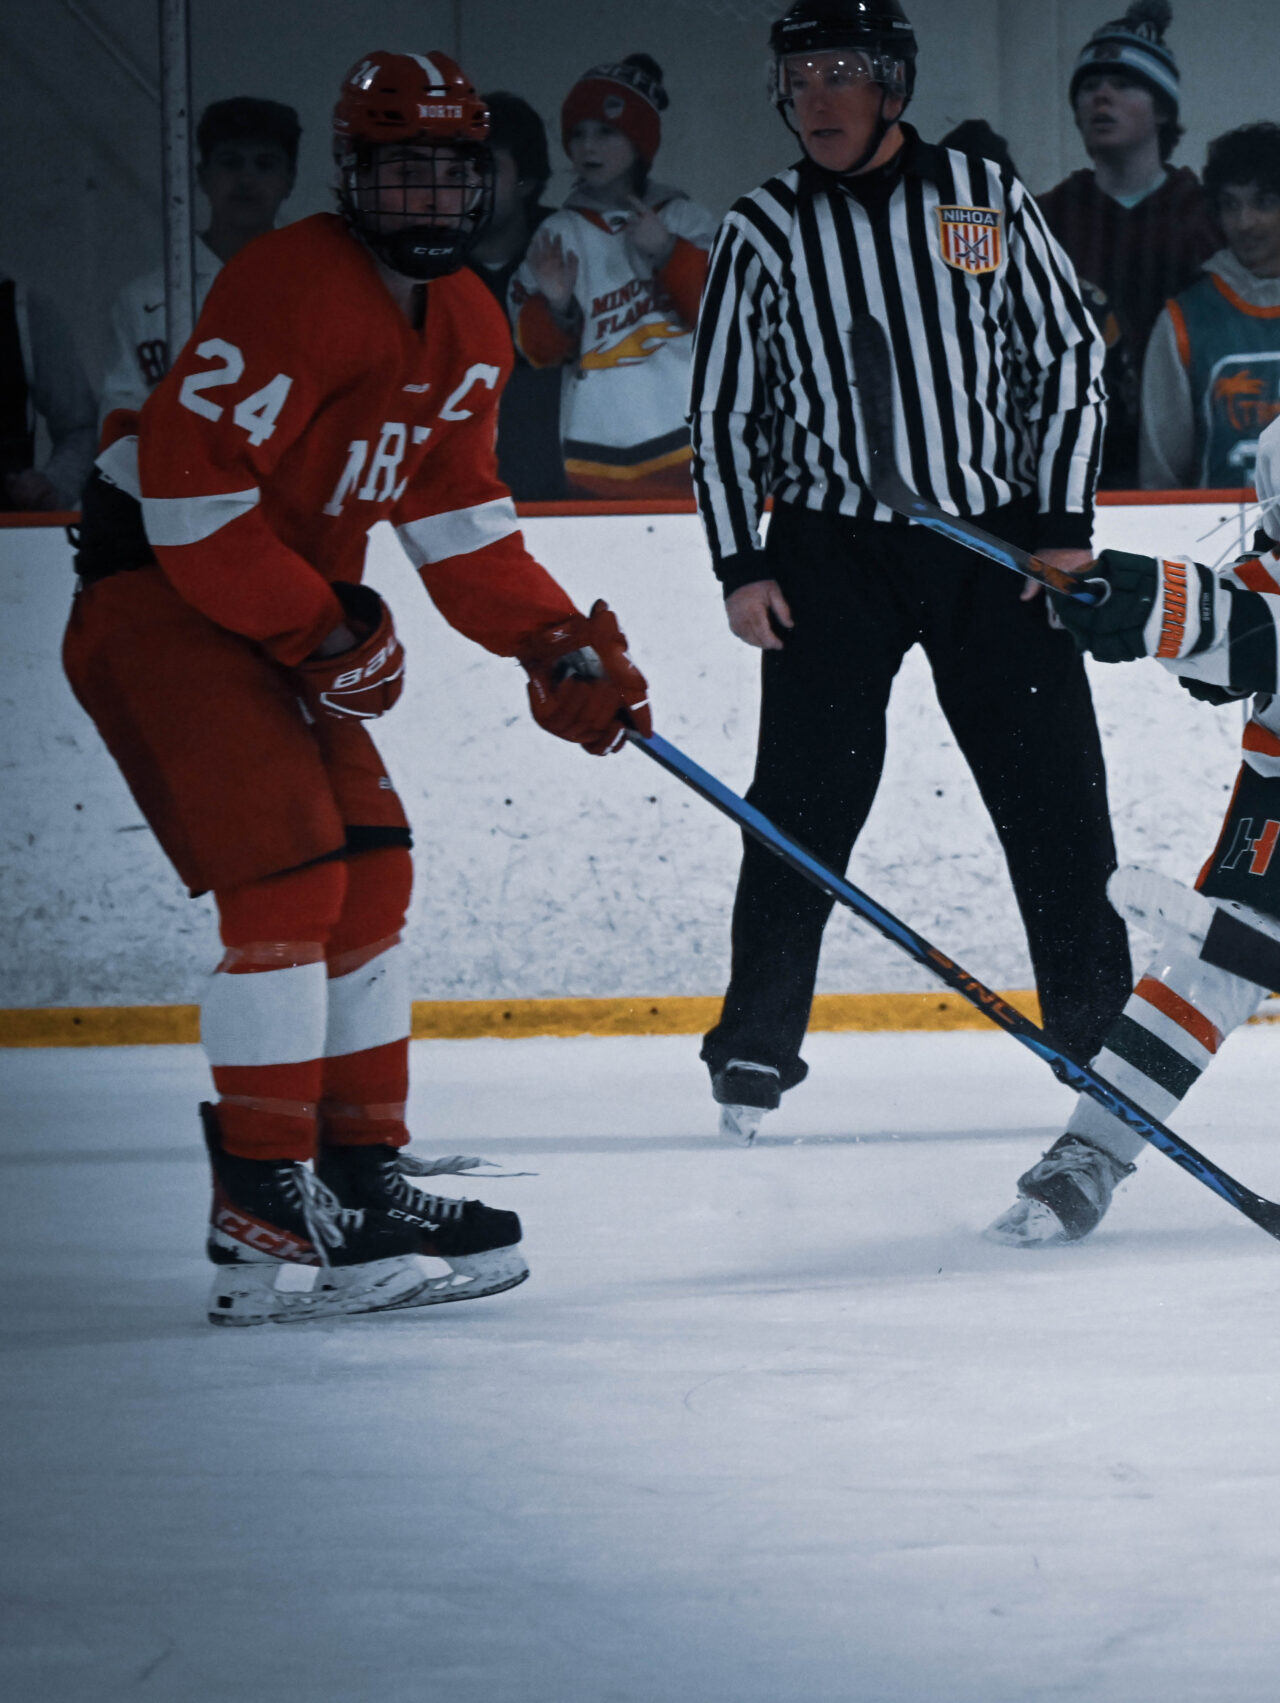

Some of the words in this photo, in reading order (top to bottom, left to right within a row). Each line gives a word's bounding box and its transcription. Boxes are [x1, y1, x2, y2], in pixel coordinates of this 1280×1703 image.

[417, 103, 463, 118] NORTH
[943, 209, 995, 226] NIHOA
[413, 246, 454, 256] CCM
[178, 338, 294, 447] 24
[438, 362, 500, 421] C
[386, 1210, 440, 1232] CCM
[216, 1208, 318, 1263] CCM
